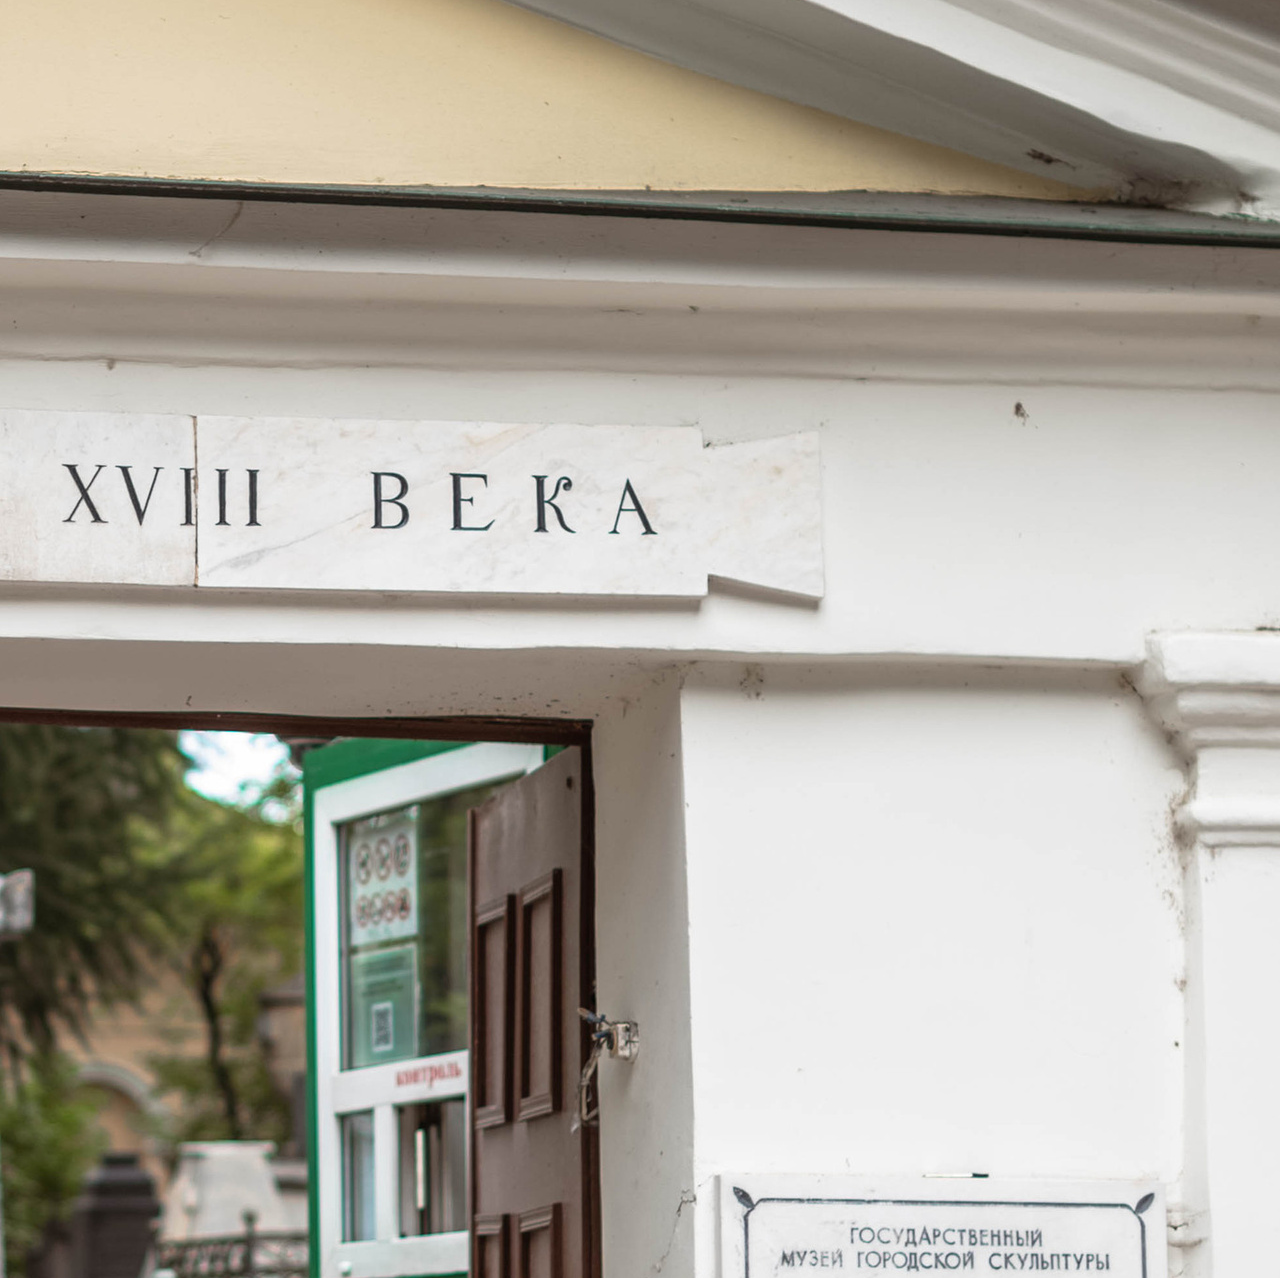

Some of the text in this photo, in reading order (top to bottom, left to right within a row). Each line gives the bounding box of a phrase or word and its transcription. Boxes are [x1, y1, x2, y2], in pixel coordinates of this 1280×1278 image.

[62, 462, 262, 527] XVIII
[370, 471, 659, 537] ВЕКА
[850, 1225, 1043, 1249] ГОСУДАРСТВЕННЫЙ
[779, 1247, 1111, 1272] МУЗЕЙ ГОРОДСКОЙ СКУЛЬПТУРЫ
